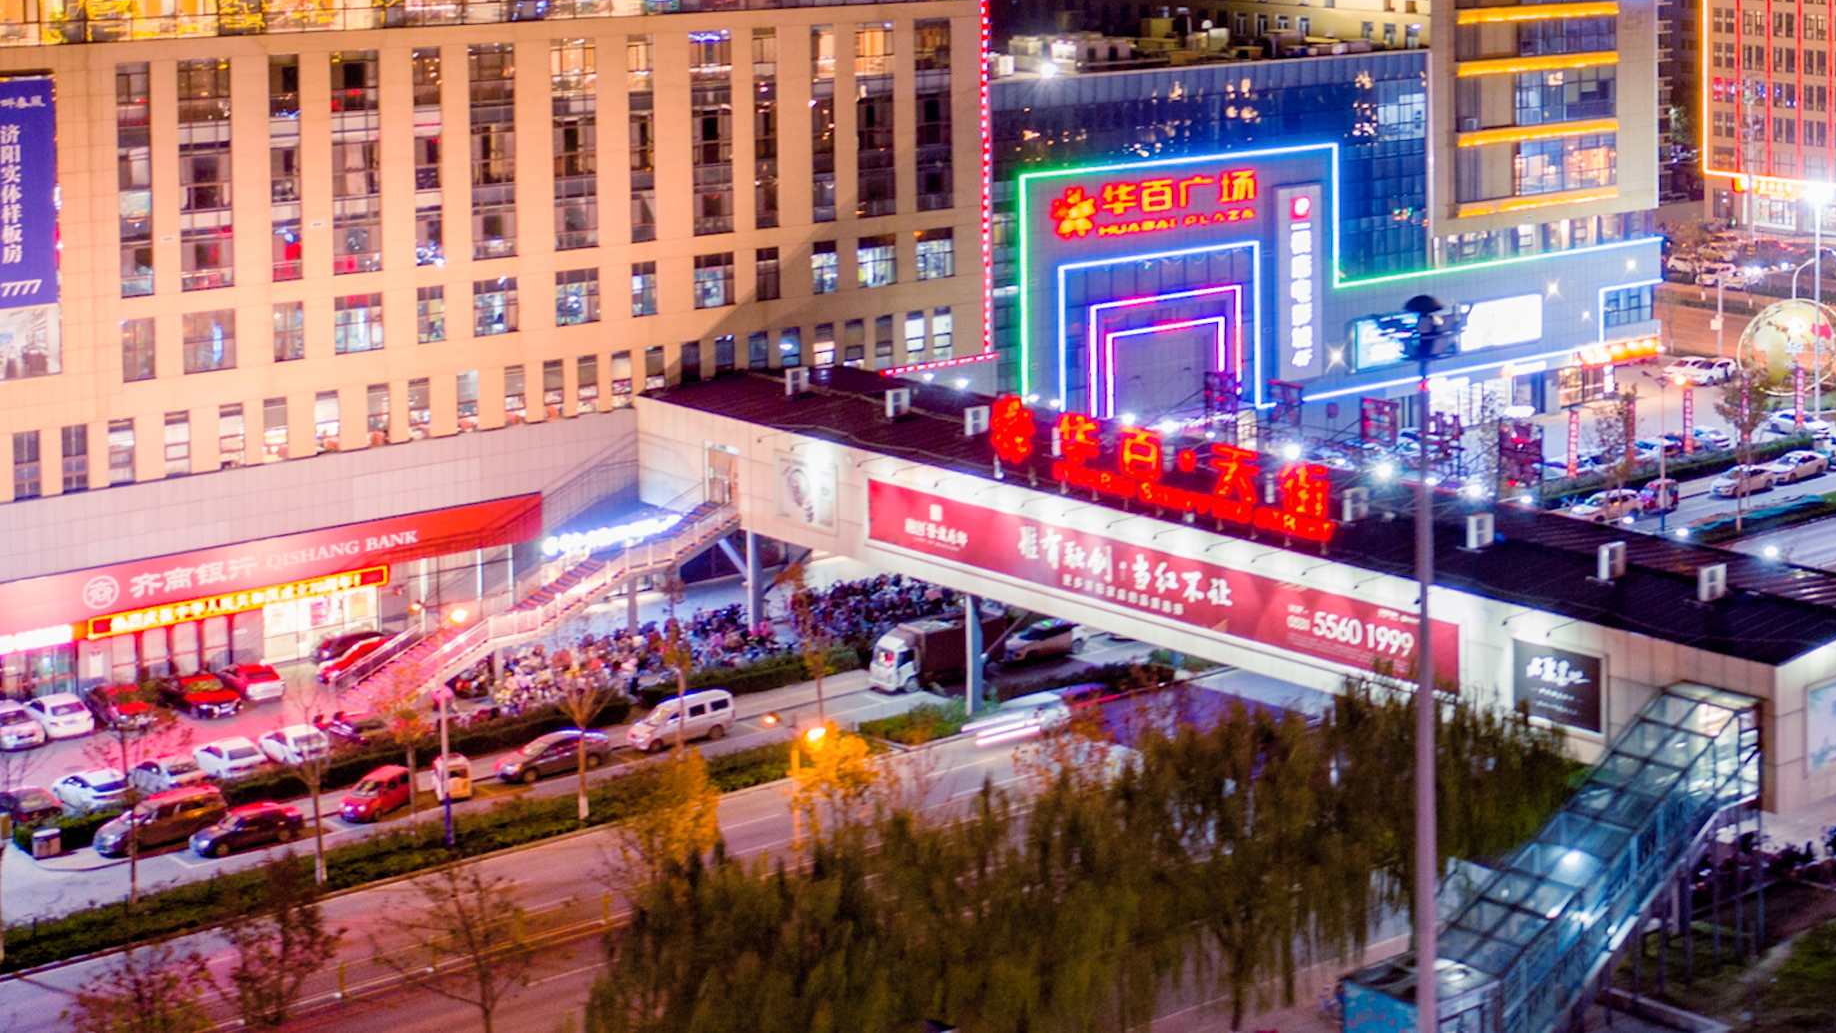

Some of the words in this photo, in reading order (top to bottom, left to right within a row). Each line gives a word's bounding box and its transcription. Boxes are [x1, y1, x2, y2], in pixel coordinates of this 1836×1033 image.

[0, 124, 23, 264] 济阳实体样板房
[1101, 169, 1257, 215] 华百广场
[1098, 218, 1177, 237] HUABAI
[1185, 208, 1257, 227] PLAZA
[265, 540, 360, 569] QISHANG
[365, 530, 419, 553] BANK
[129, 556, 259, 598] 齐商银行
[1312, 611, 1363, 645] 5560
[1365, 623, 1415, 657] 1999
